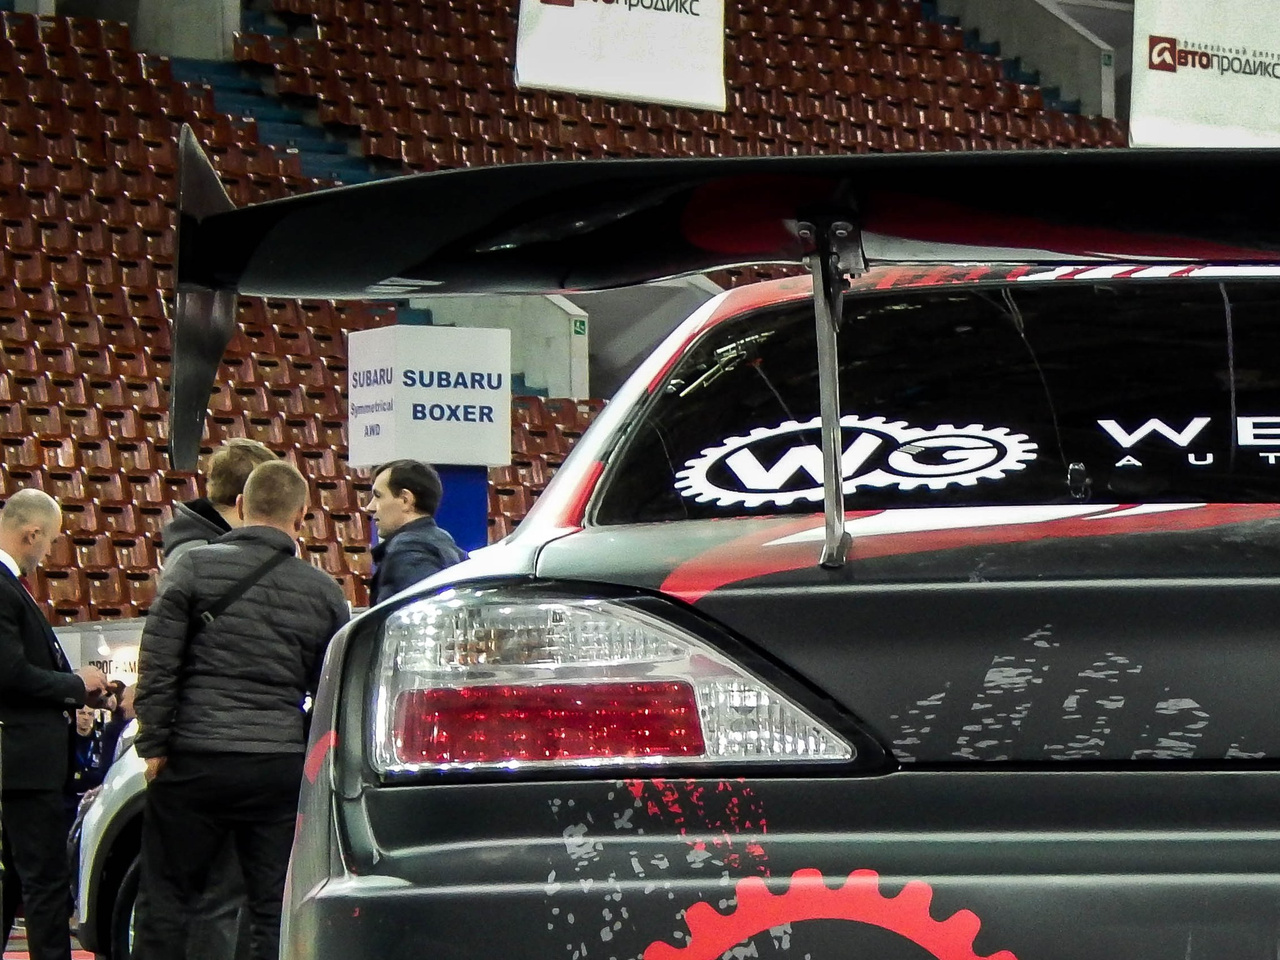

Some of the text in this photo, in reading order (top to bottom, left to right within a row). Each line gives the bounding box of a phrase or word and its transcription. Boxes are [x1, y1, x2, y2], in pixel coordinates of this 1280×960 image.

[352, 366, 394, 389] SUBARU
[402, 368, 503, 391] SUBARU
[350, 398, 394, 419] Symmetrical
[412, 403, 495, 423] BOXER
[363, 423, 381, 437] AWD
